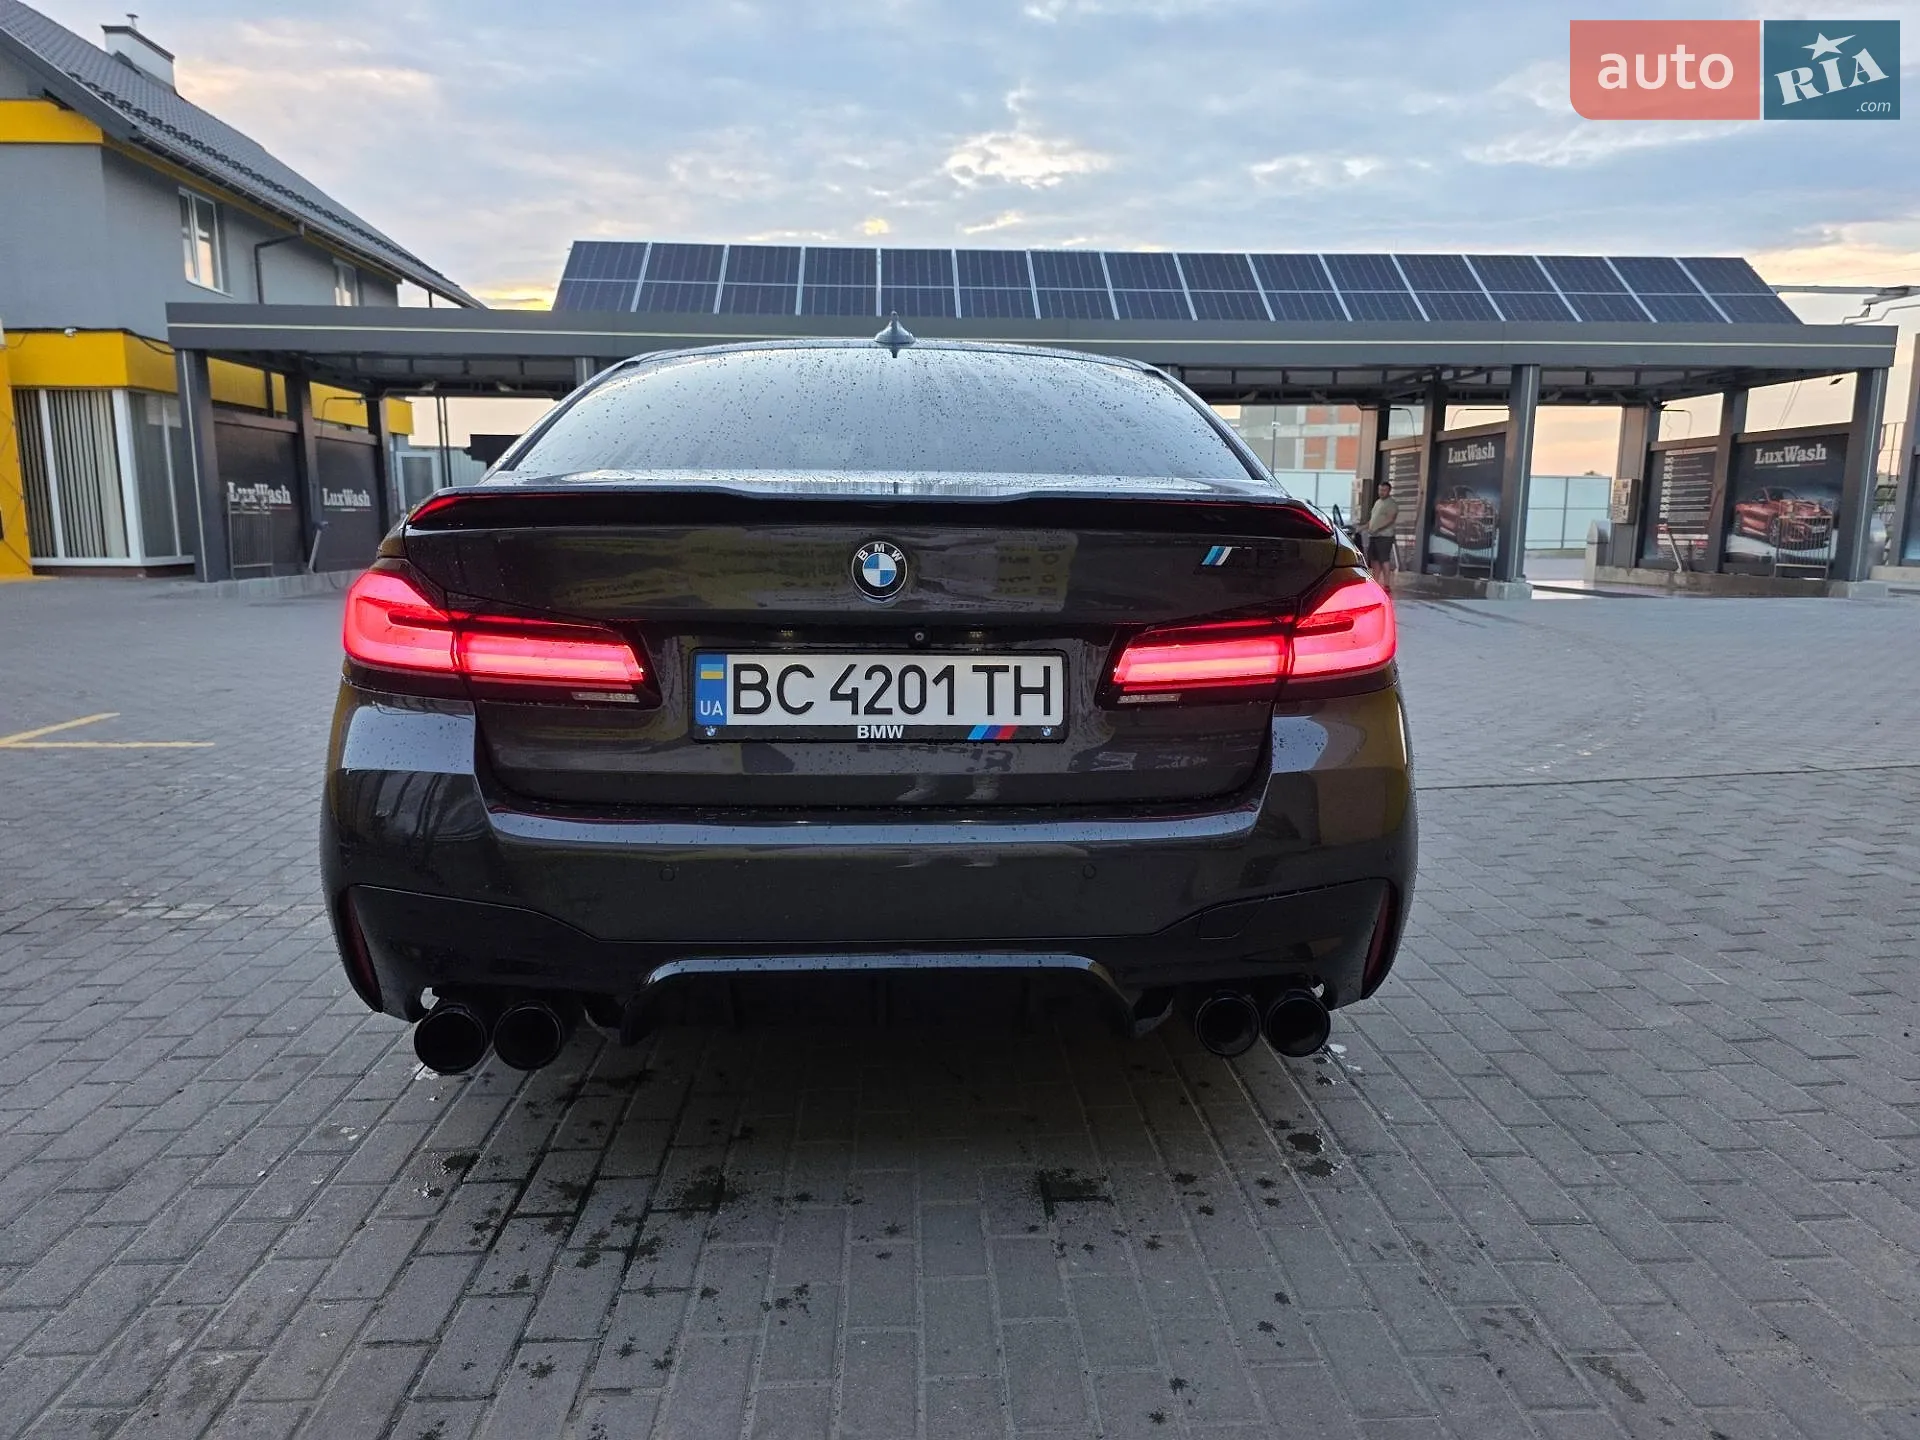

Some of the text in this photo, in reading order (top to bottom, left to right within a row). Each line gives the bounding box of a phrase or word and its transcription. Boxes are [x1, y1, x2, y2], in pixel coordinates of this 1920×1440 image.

[1448, 442, 1495, 463] LuxWash
[1755, 443, 1826, 464] LuxWash
[227, 482, 292, 504] LuxWash
[322, 488, 371, 506] LuxWash
[857, 543, 903, 562] BMW
[732, 663, 1051, 716] BC 4201 TH
[699, 701, 724, 716] UA
[857, 725, 904, 739] BMW
